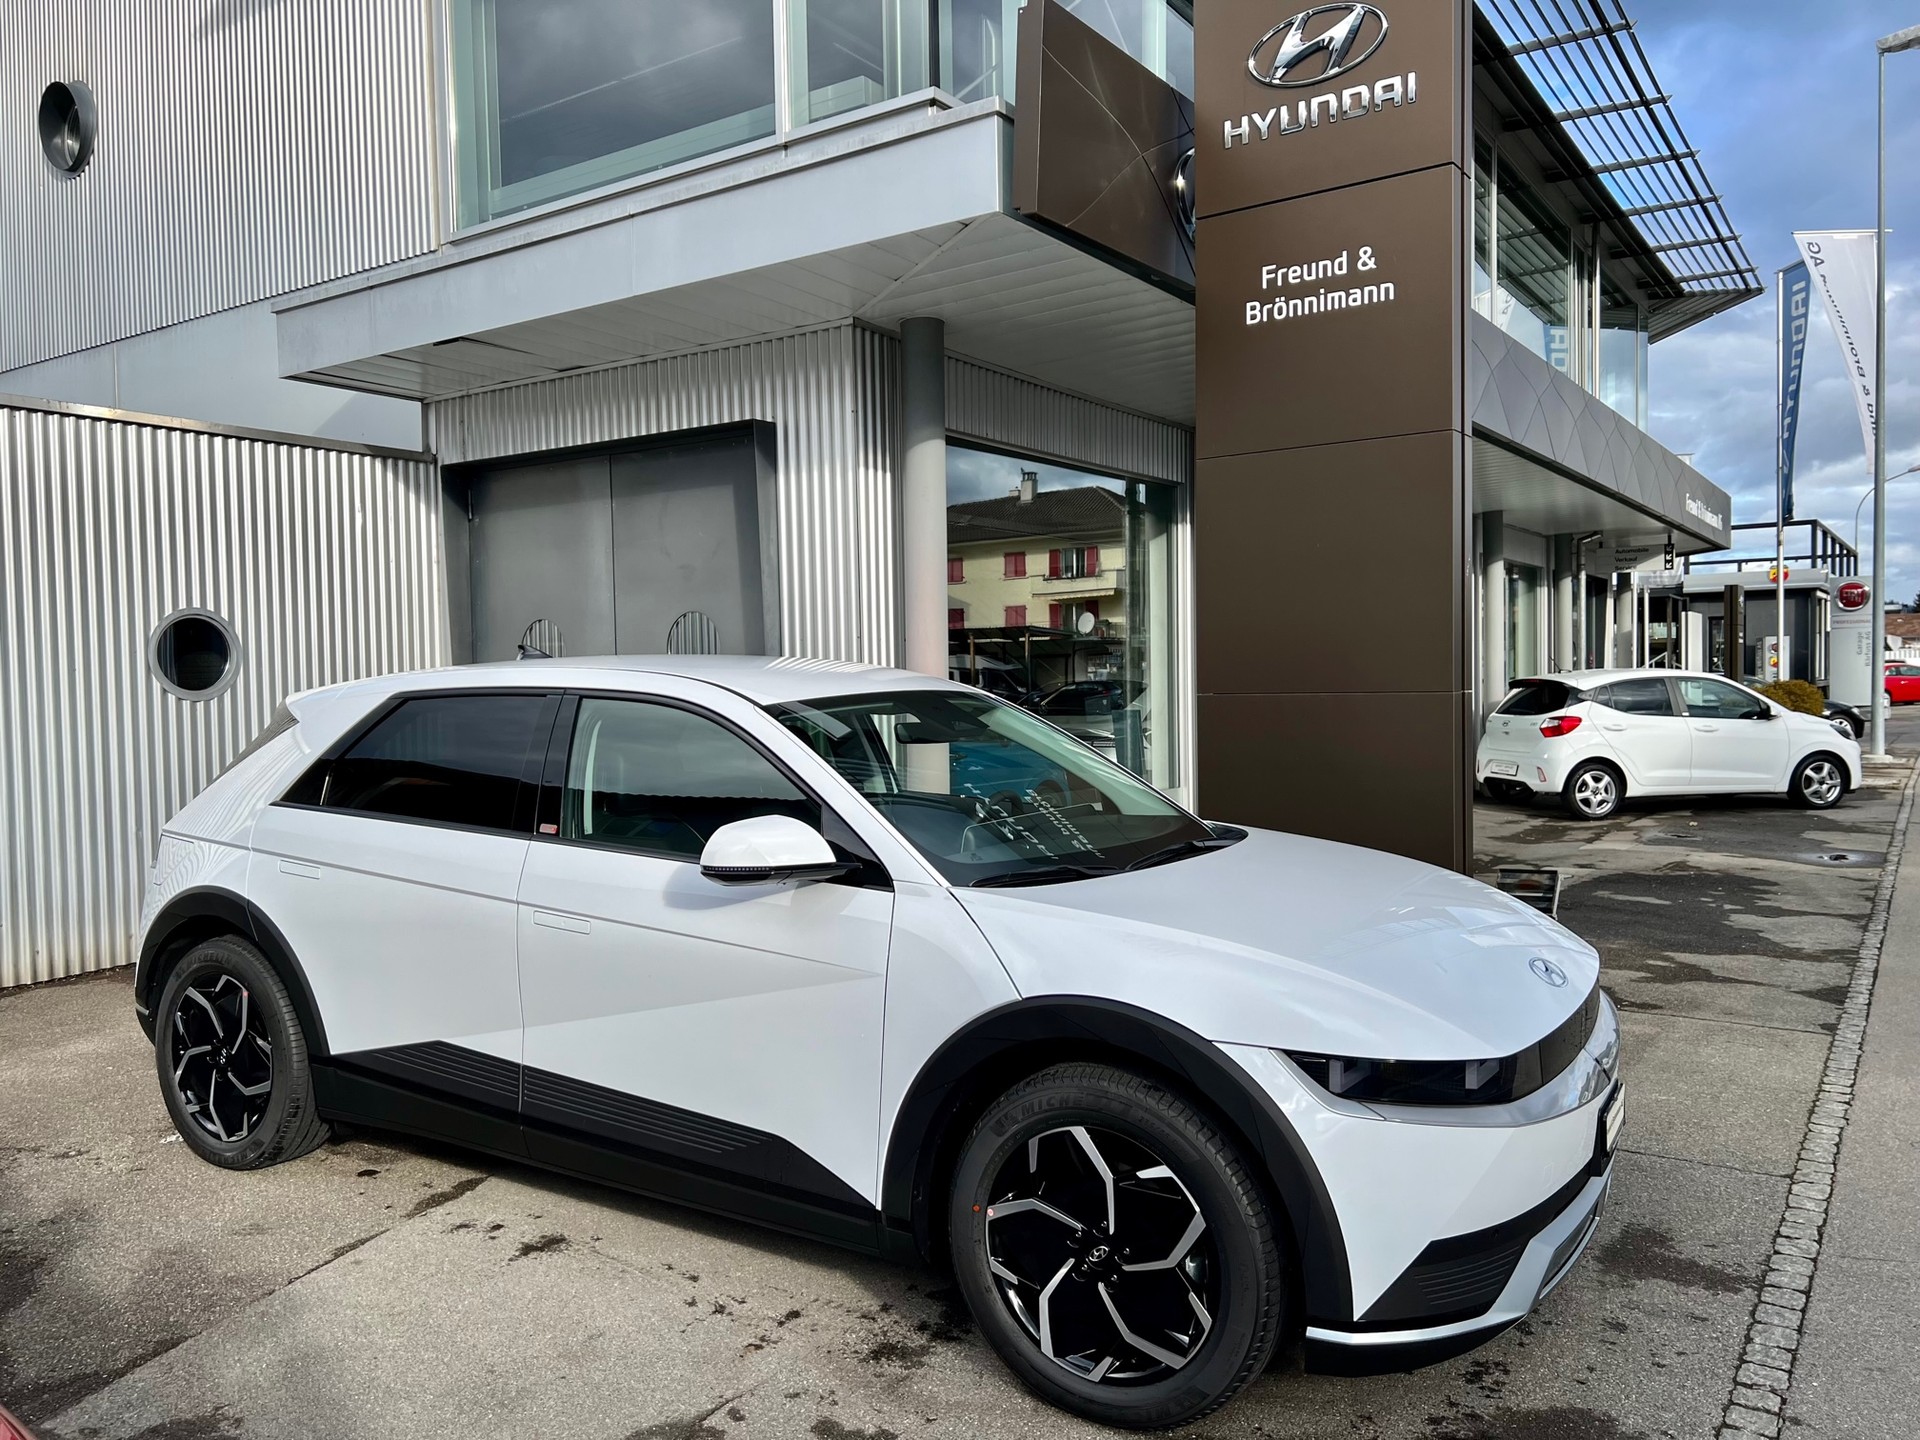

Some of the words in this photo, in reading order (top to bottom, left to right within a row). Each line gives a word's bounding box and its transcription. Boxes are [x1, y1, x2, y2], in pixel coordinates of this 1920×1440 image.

[1224, 71, 1417, 149] HYUNDAI
[1262, 251, 1348, 289] Freund
[1357, 246, 1377, 271] &
[1246, 282, 1395, 325] Brönnimann
[1783, 280, 1806, 439] HYUNDAI
